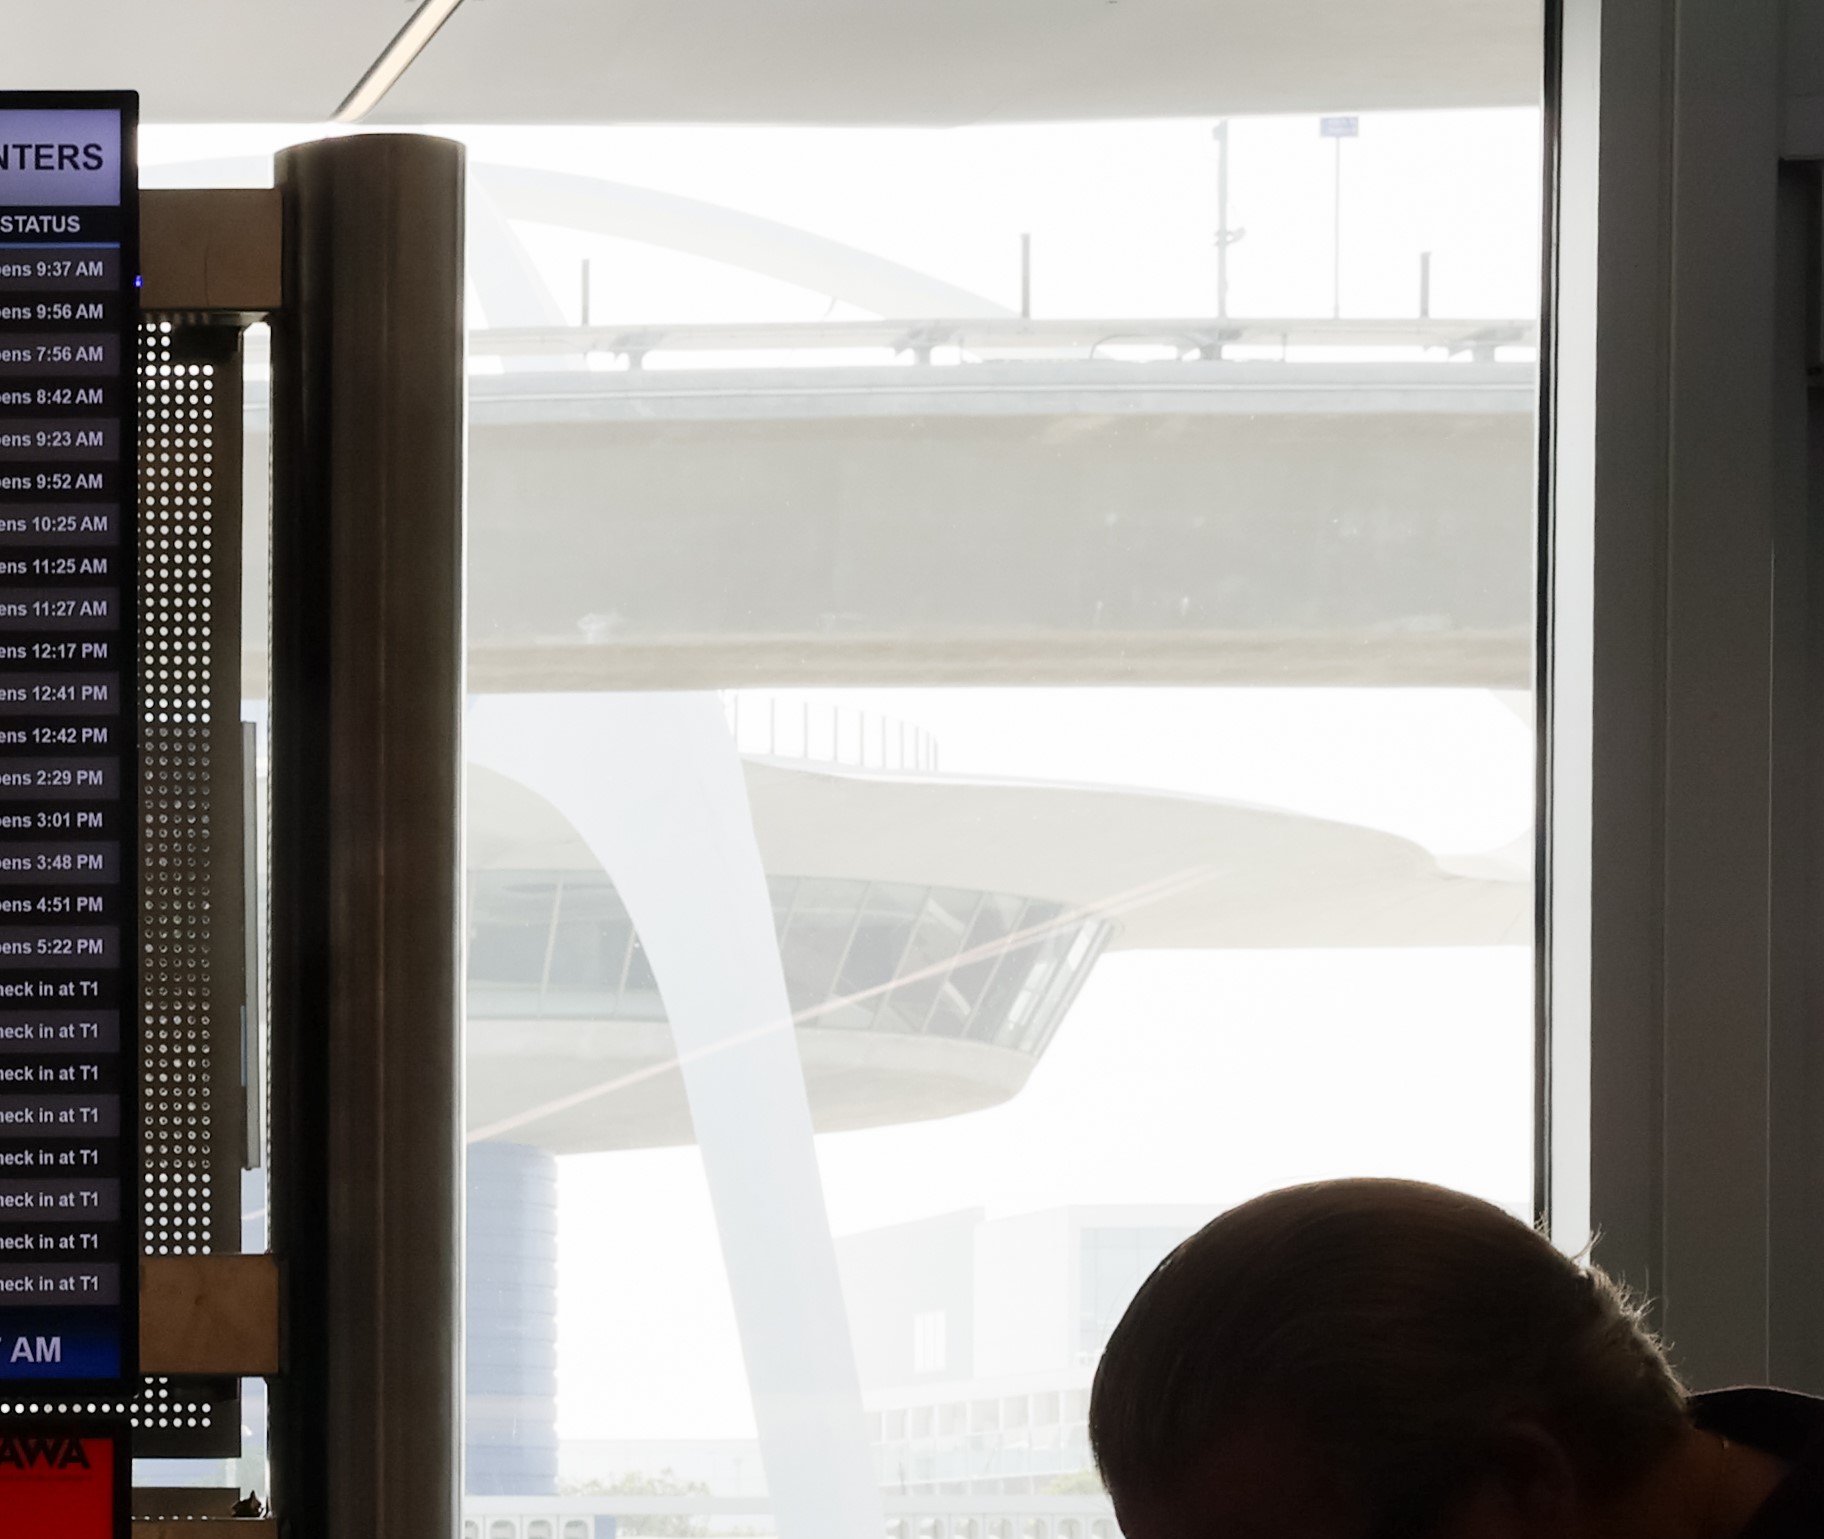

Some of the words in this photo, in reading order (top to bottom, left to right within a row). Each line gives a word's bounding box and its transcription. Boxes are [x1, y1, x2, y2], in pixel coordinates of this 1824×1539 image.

[0, 216, 80, 232] STATUS
[37, 261, 71, 276] 9:37
[76, 261, 102, 276] AM
[11, 1337, 60, 1362] AM
